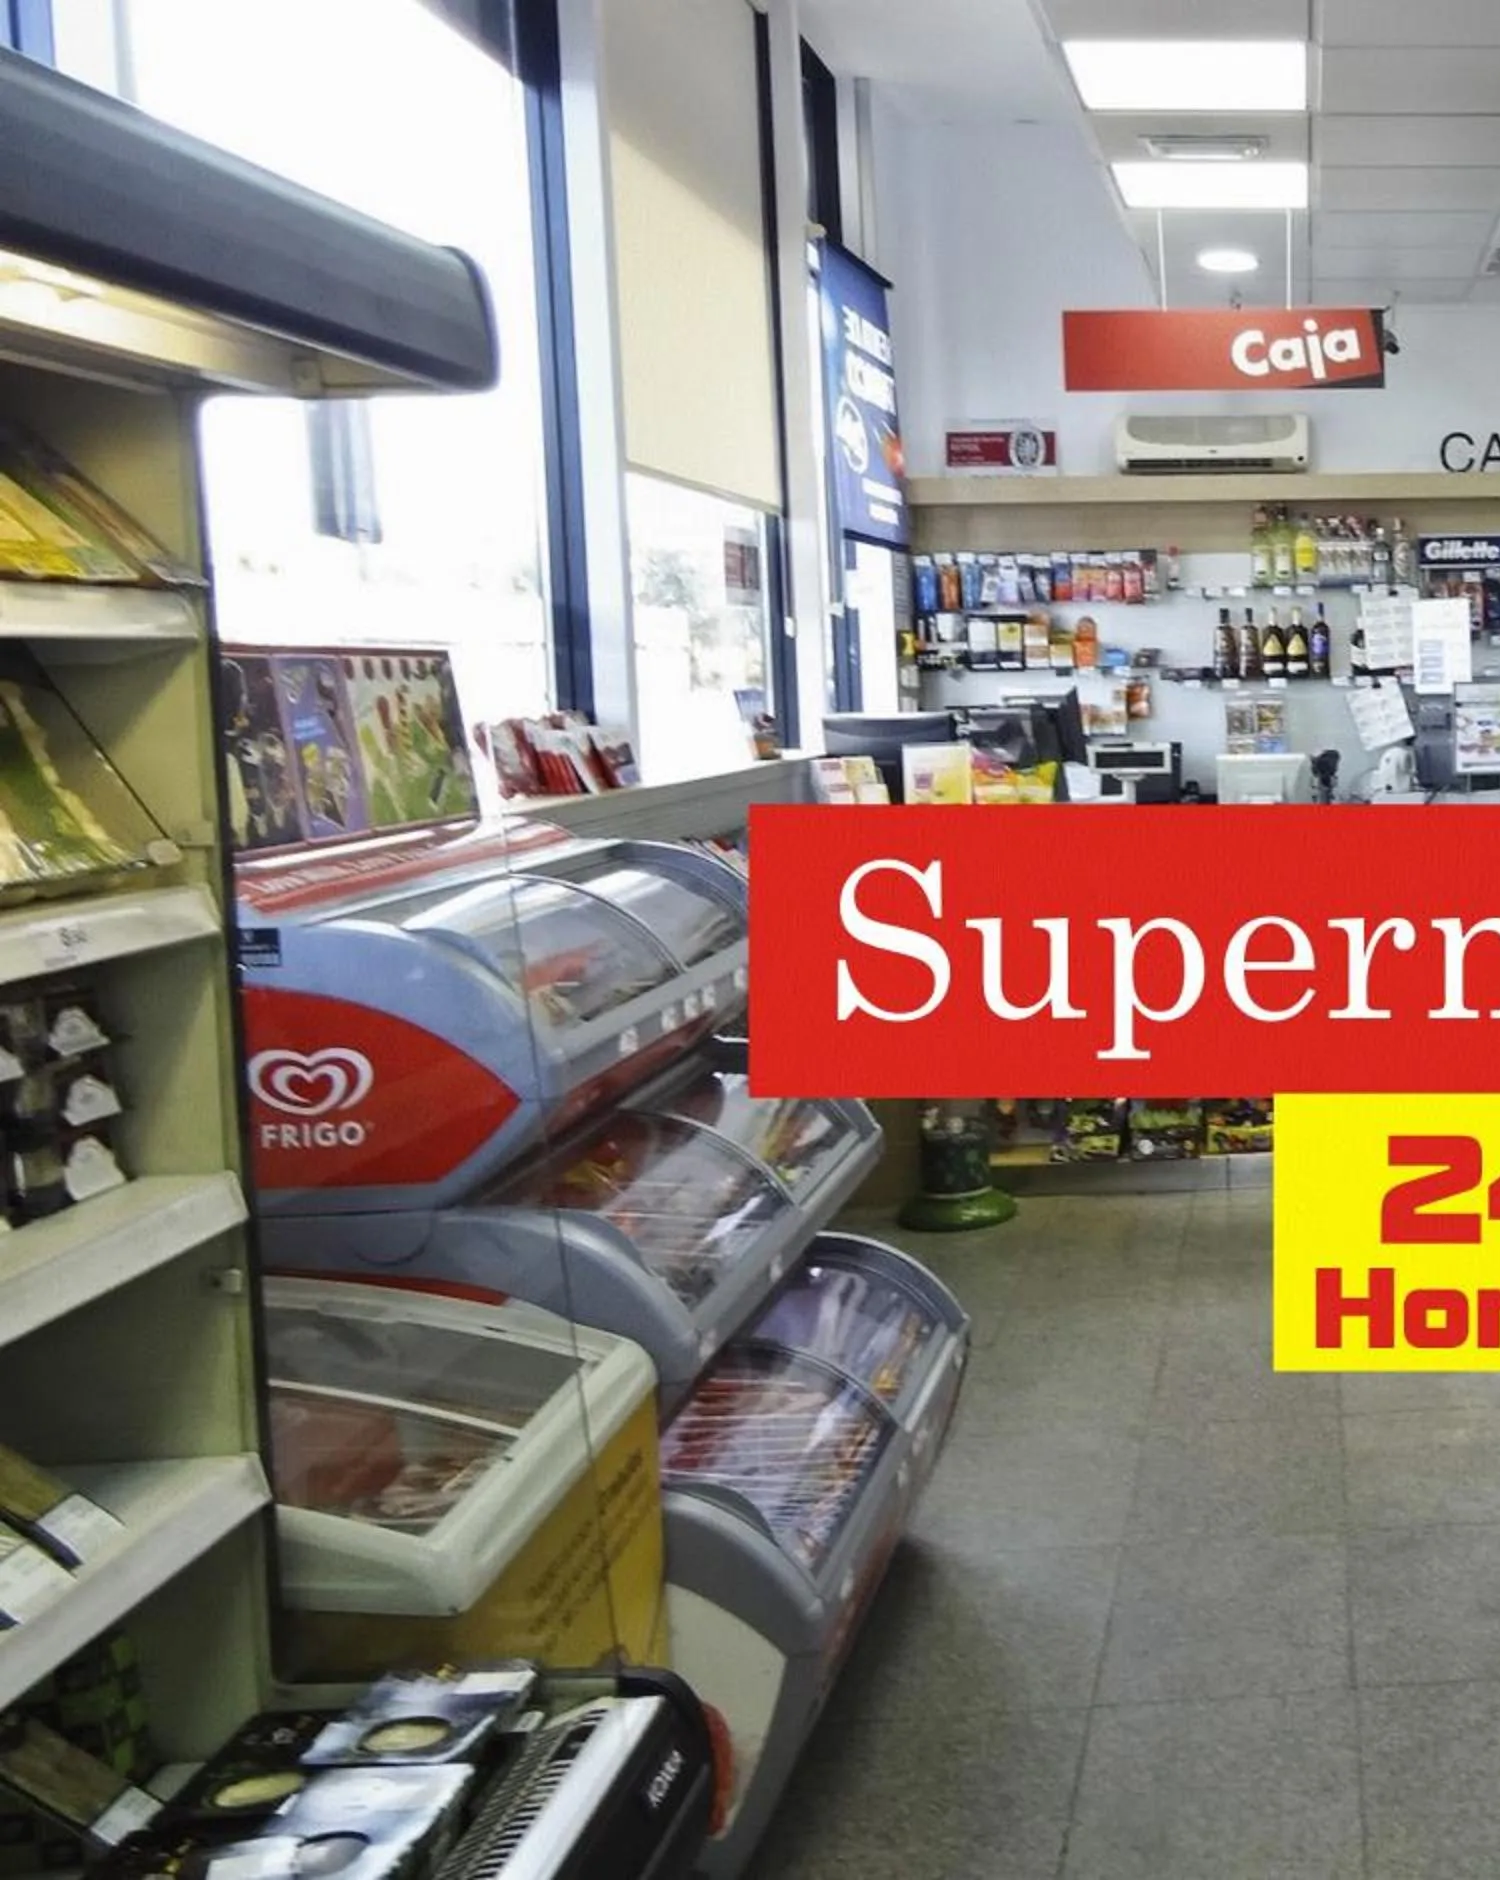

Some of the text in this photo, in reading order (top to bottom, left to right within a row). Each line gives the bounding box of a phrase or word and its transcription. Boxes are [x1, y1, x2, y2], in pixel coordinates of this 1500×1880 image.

[1231, 319, 1361, 380] Caja
[1424, 540, 1500, 560] Gillette
[261, 1121, 366, 1149] FRIGO
